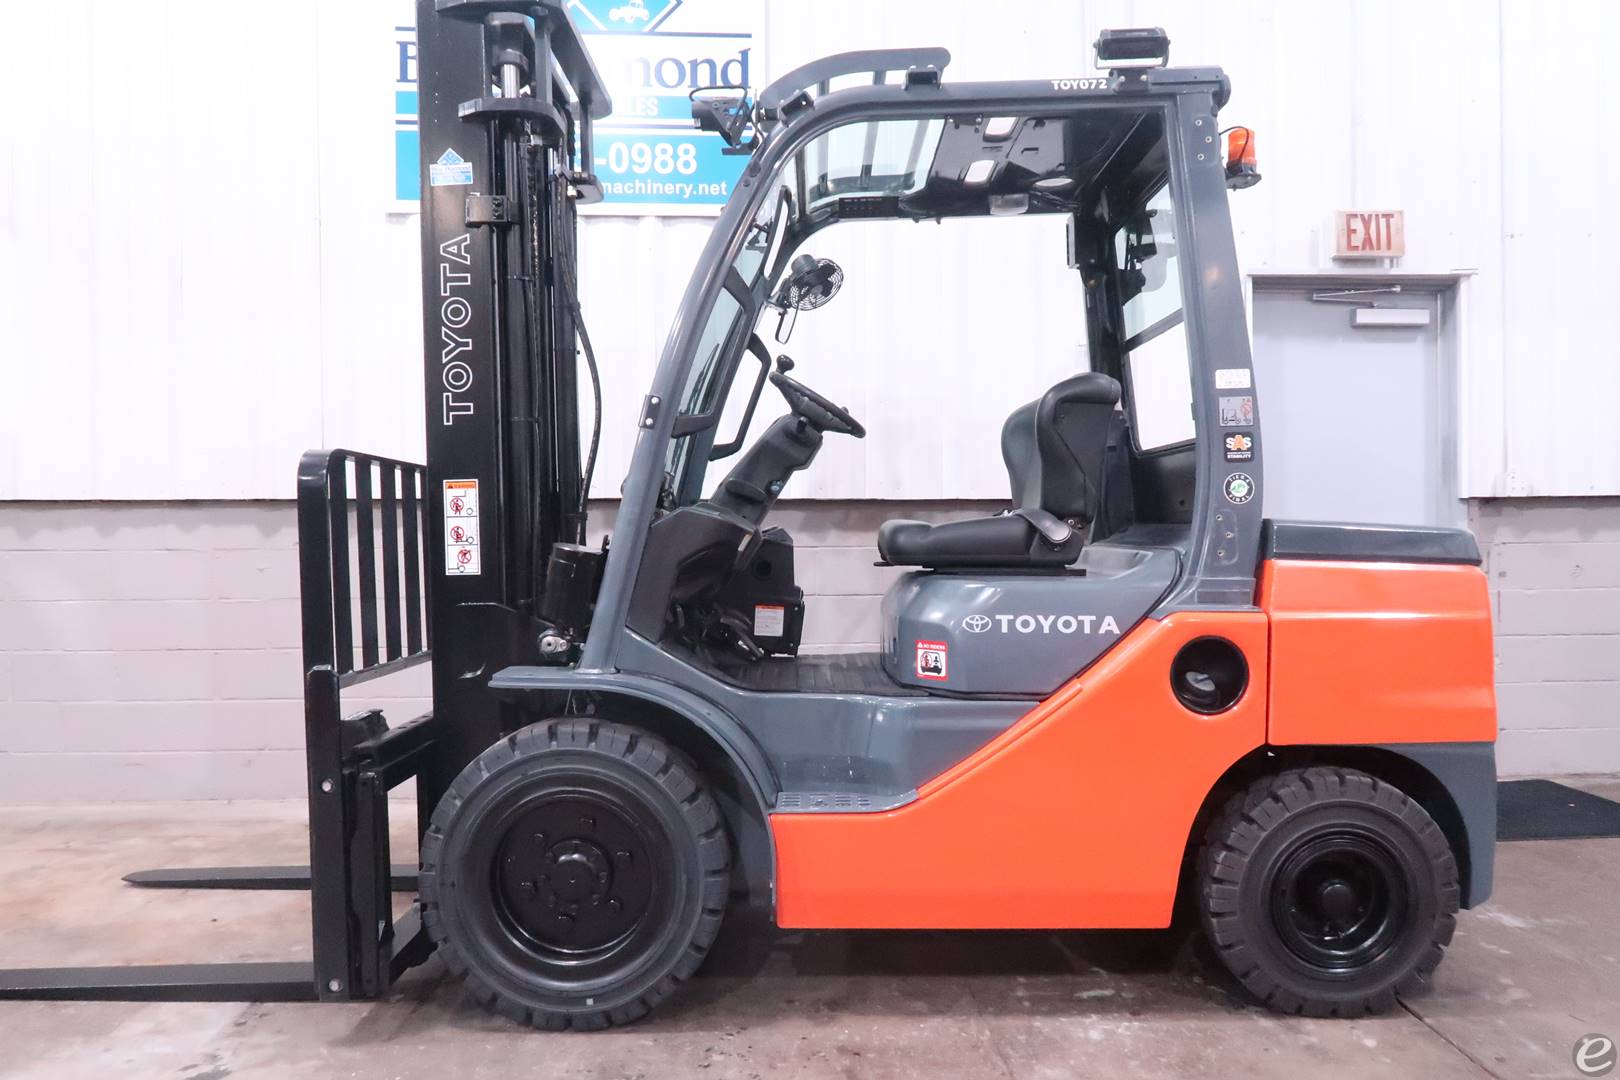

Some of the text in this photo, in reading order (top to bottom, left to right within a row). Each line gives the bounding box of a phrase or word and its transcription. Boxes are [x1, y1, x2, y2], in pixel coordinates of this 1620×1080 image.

[1051, 79, 1108, 90] TOY072
[593, 142, 698, 175] -0988
[1345, 213, 1394, 251] EXIT
[440, 233, 473, 425] TOYOTA
[1226, 434, 1252, 451] SAS
[995, 614, 1120, 634] TOYOTA
